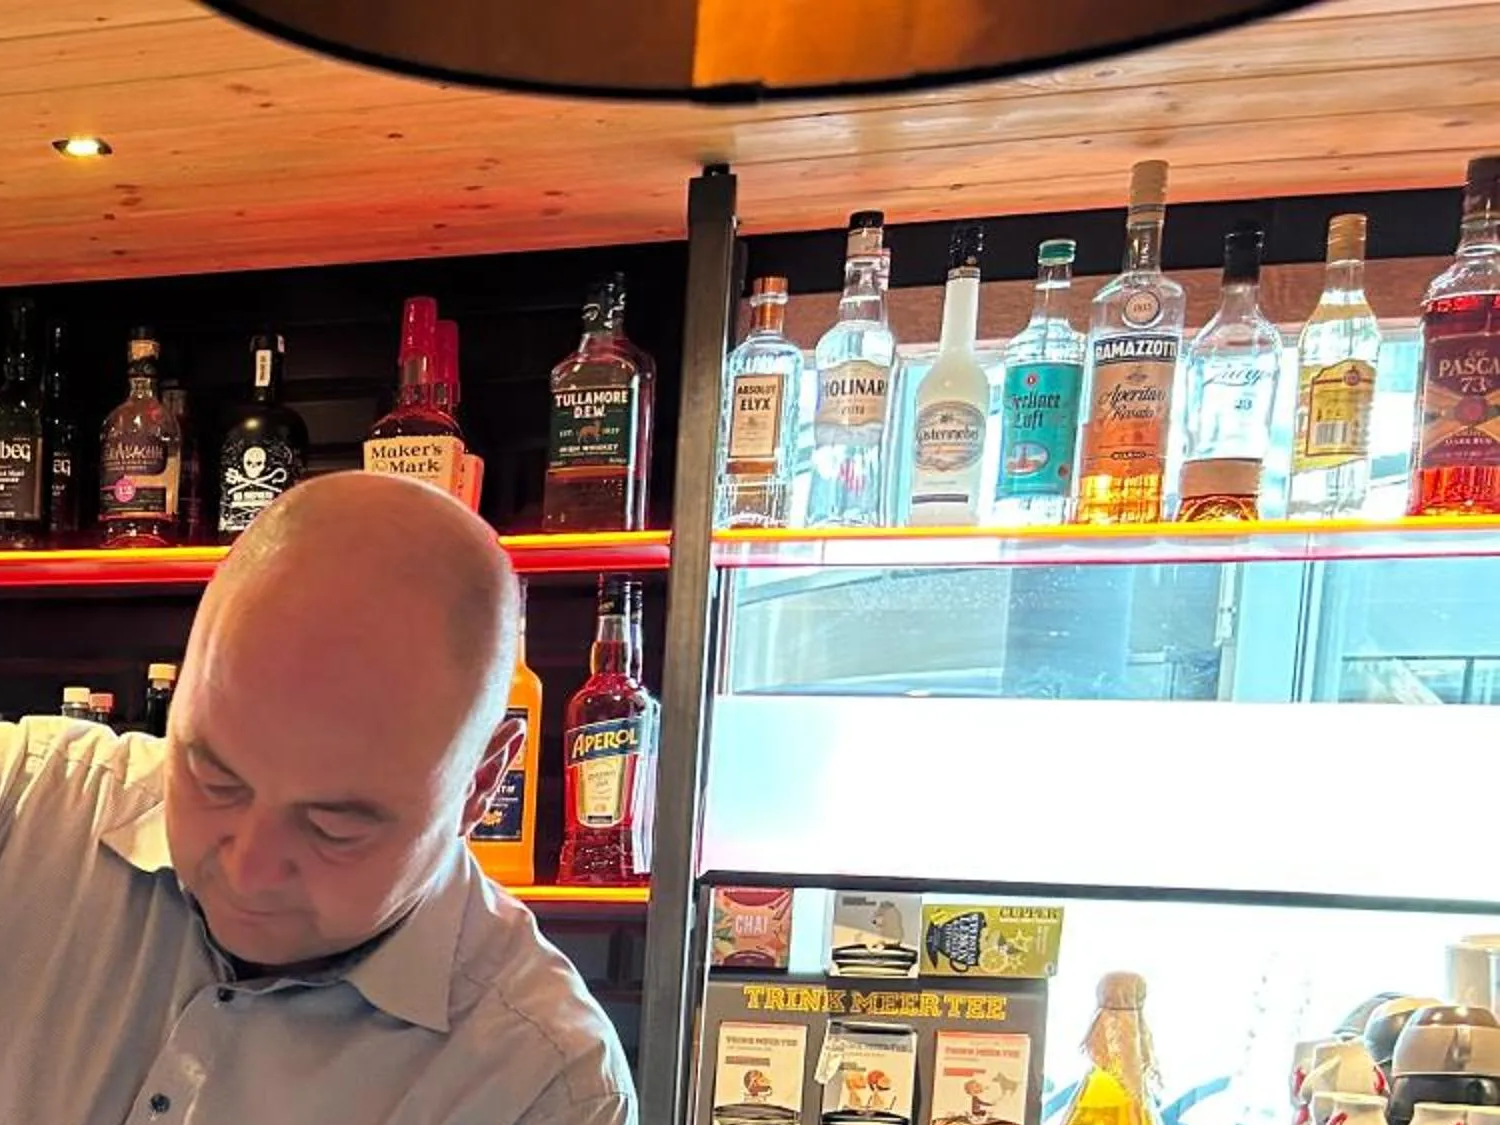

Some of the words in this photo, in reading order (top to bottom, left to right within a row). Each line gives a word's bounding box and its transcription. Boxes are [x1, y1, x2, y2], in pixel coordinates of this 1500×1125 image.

[1439, 357, 1500, 377] PASCA
[555, 391, 628, 408] TULLAMORE
[740, 397, 771, 411] ELYX
[371, 443, 443, 459] Maker's
[389, 459, 441, 473] Mark
[572, 727, 639, 759] APEROL
[744, 986, 847, 1013] TRINK
[850, 991, 942, 1018] MEER
[943, 994, 1008, 1021] TEE
